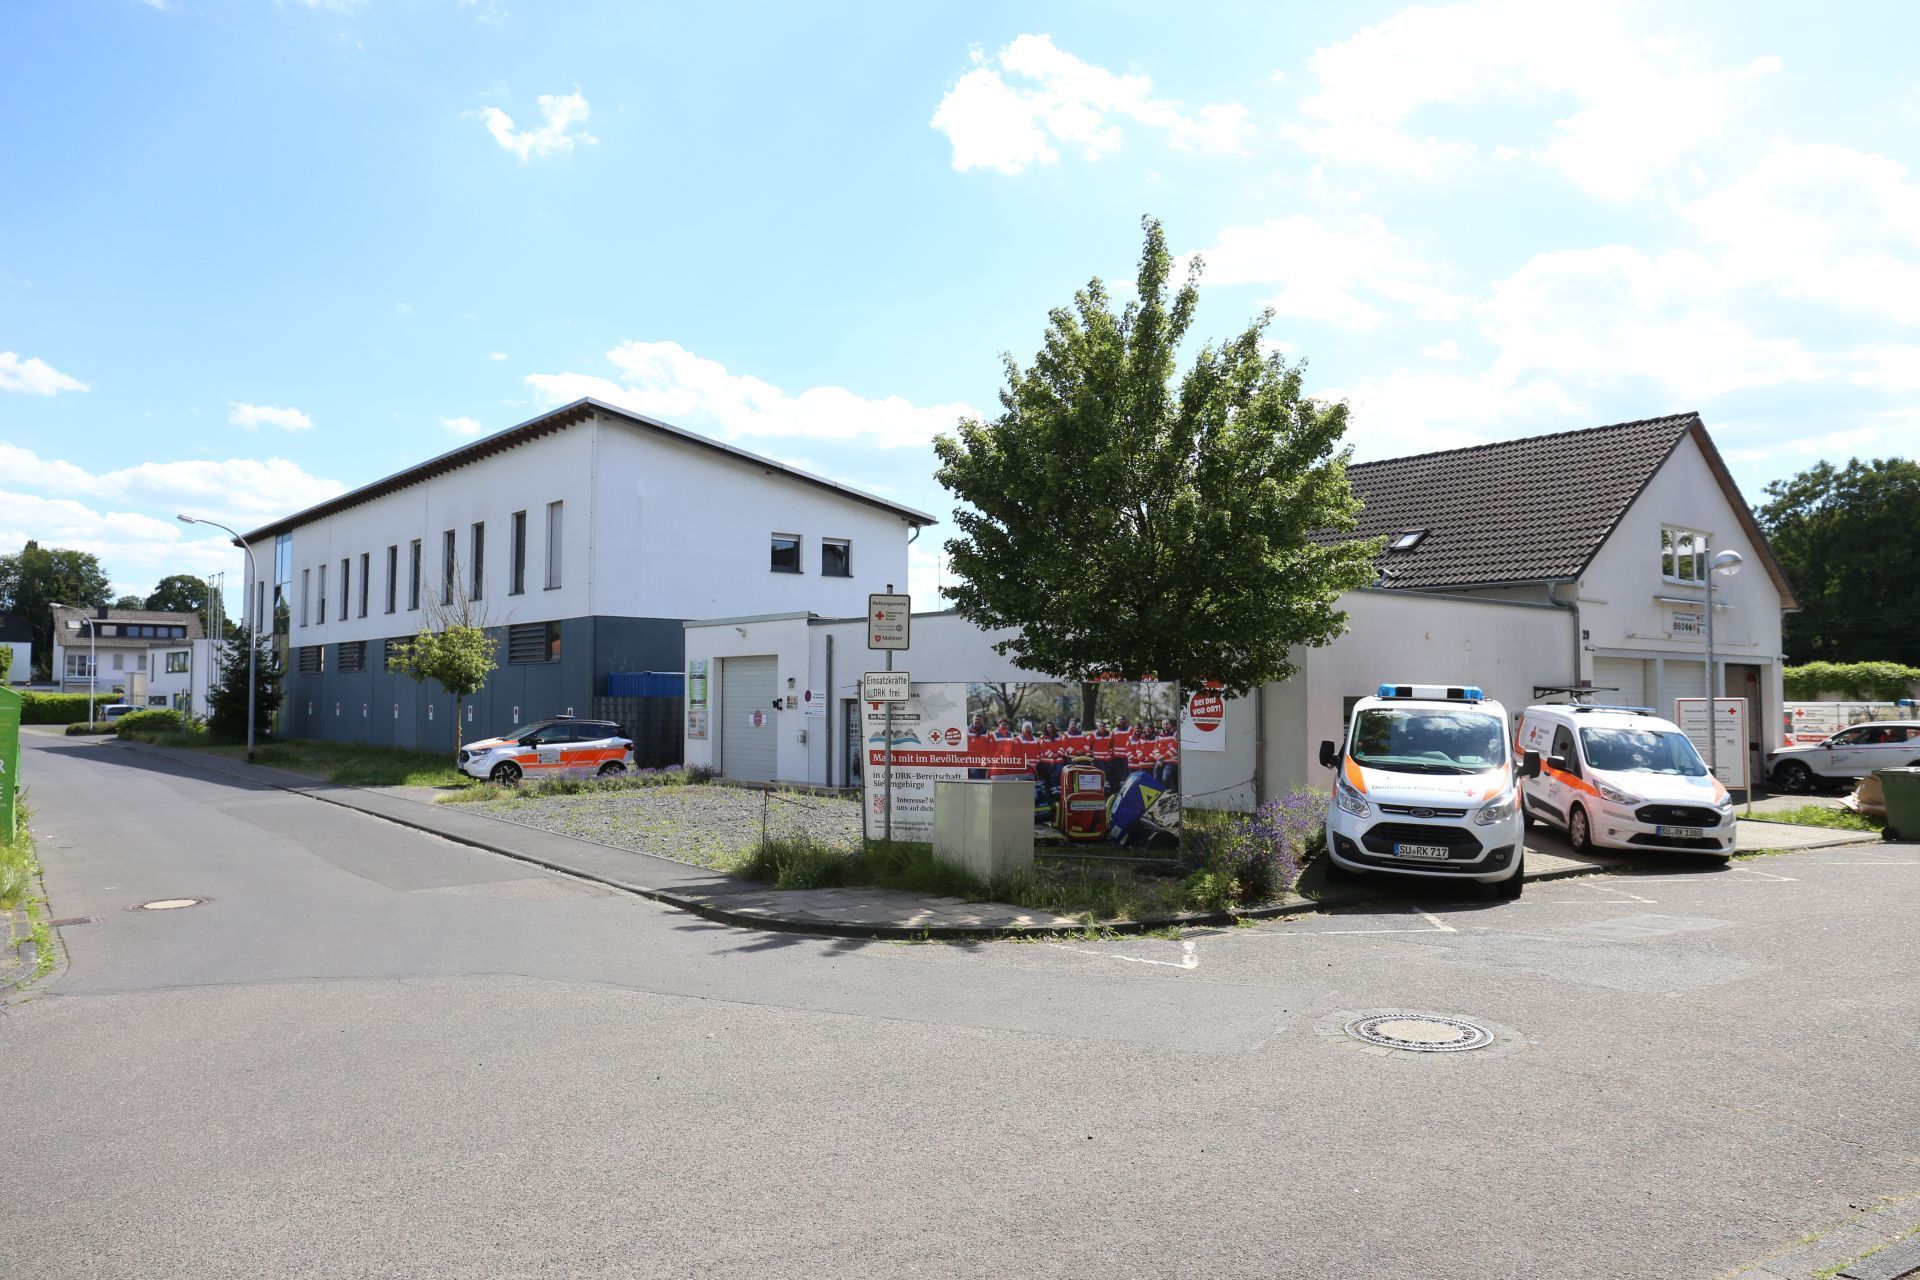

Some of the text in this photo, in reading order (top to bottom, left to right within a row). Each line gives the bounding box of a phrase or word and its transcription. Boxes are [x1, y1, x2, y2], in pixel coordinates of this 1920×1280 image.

[866, 676, 907, 685] Einsatzkräfte
[873, 688, 886, 697] DRK
[889, 688, 901, 697] frei
[1192, 705, 1222, 715] VOR ORT!
[873, 753, 1022, 766] Mah mit im Bevölkerungsschutz
[873, 780, 925, 790] Sieengebirge
[1399, 845, 1448, 857] SU RK 717
